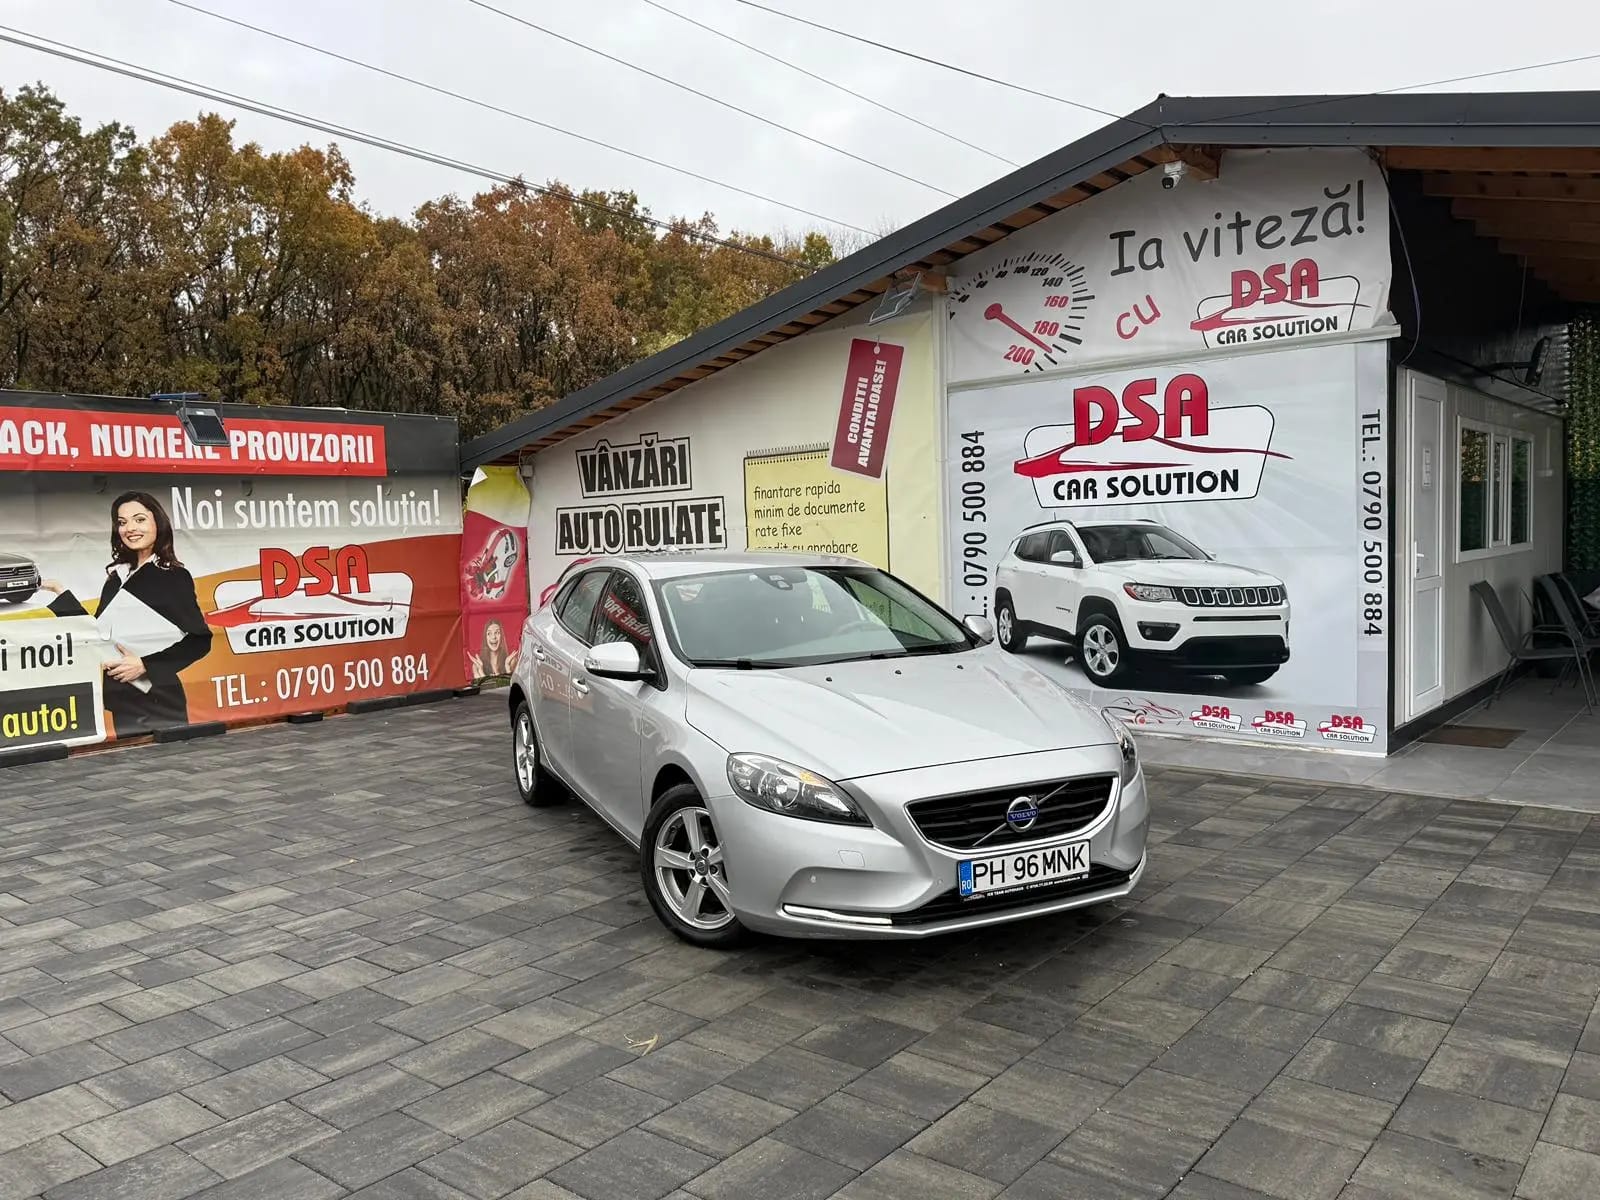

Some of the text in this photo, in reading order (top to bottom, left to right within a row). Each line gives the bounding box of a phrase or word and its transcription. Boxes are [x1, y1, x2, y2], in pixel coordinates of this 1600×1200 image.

[1109, 179, 1365, 277] Ia viteză!
[1030, 267, 1049, 277] 120
[1042, 277, 1063, 288] 140
[1231, 257, 1320, 309] DSA
[1044, 295, 1069, 309] 160
[1116, 294, 1162, 340] cu
[1033, 320, 1060, 337] 180
[1216, 315, 1338, 345] CAR SOLUTION
[1003, 344, 1035, 366] 200
[847, 376, 869, 444] CONDITII
[857, 359, 887, 468] AVANTAJOASE!
[1073, 373, 1209, 446] DSA
[0, 419, 79, 458] ACK,
[229, 429, 375, 464] PROVIZORII
[961, 430, 985, 473] 884
[580, 438, 688, 493] VÂNZĂRI
[1053, 468, 1239, 500] CAR SOLUTION
[171, 486, 224, 529] Noi
[234, 493, 340, 529] suntem
[753, 480, 841, 500] finantare rapida
[961, 481, 987, 523] 500
[559, 503, 723, 550] AUTO RULATE
[754, 500, 866, 519] minim de documente
[1362, 409, 1383, 636] TEL.: 0790 500 884
[755, 522, 803, 537] rate fixe
[259, 544, 371, 599] DSA
[963, 532, 988, 587] 0790
[20, 632, 74, 669] noi!
[245, 617, 395, 647] CAR SOLUTION
[211, 653, 429, 708] TEL.: 0790 500 884
[2, 695, 78, 738] auto!
[1201, 704, 1230, 720] DSA
[1209, 721, 1236, 730] SOLUTION
[1264, 710, 1295, 725] DSA
[1331, 714, 1364, 730] DSA
[1272, 728, 1301, 737] SOLUTION
[1339, 734, 1370, 742] SOLUTION
[1010, 810, 1037, 819] VOLVO
[961, 844, 1086, 891] RO PH 96 MNK
